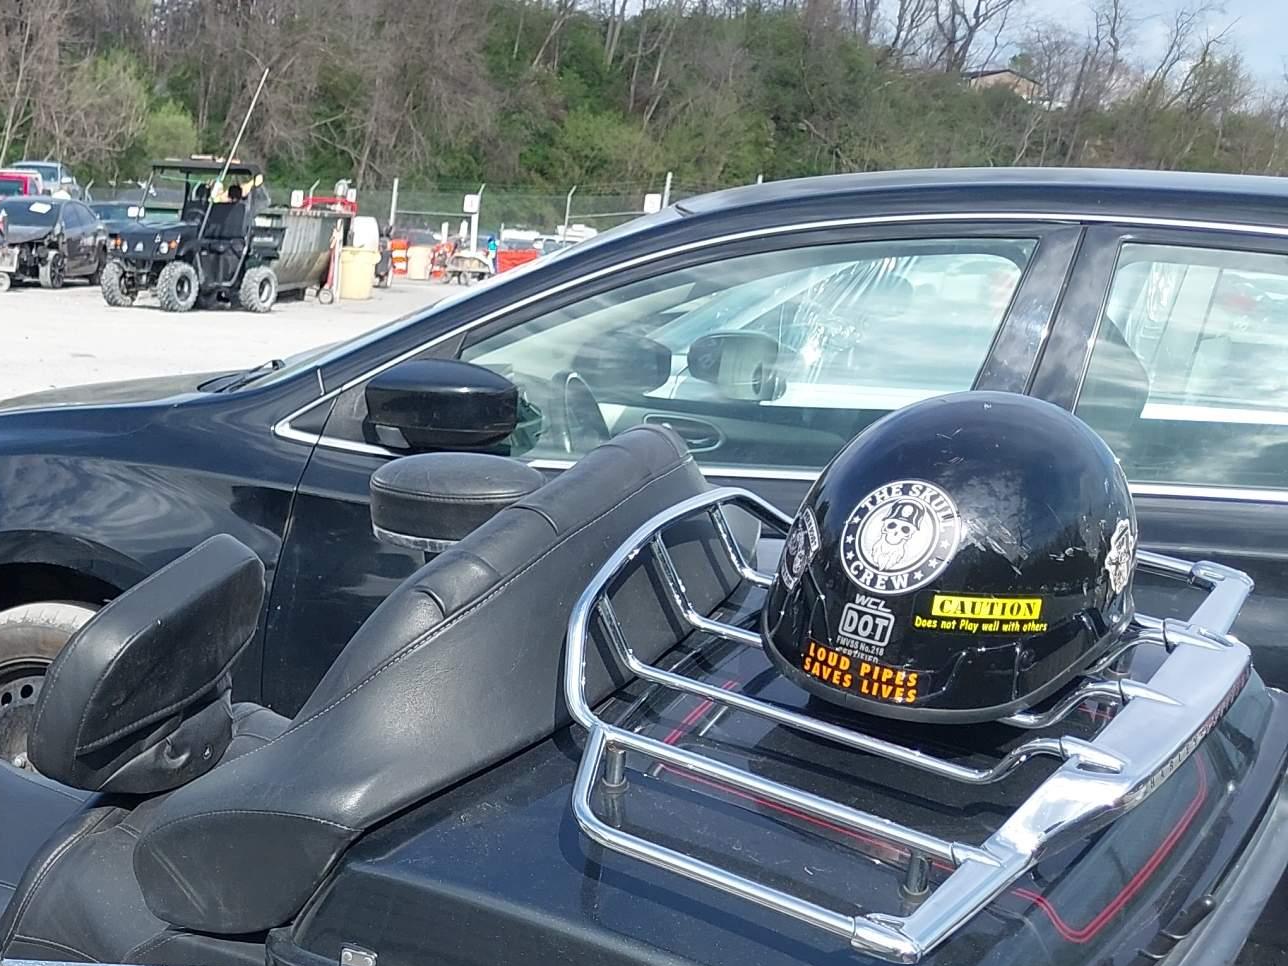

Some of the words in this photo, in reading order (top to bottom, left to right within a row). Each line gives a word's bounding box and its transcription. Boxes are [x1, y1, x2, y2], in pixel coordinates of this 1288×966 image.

[861, 484, 903, 512] THE
[850, 561, 909, 590] CREW
[855, 593, 891, 612] WCL
[939, 599, 1038, 617] CAUTION
[843, 609, 889, 641] DOT
[914, 615, 938, 628] Does
[941, 619, 957, 630] not
[959, 619, 979, 634] Play
[982, 621, 1000, 632] well
[1002, 622, 1020, 632] with
[1022, 622, 1048, 633] others
[809, 642, 851, 670] LOUD
[859, 662, 918, 687] PIPES
[803, 656, 852, 688] SAVES
[861, 679, 917, 702] LIVES
